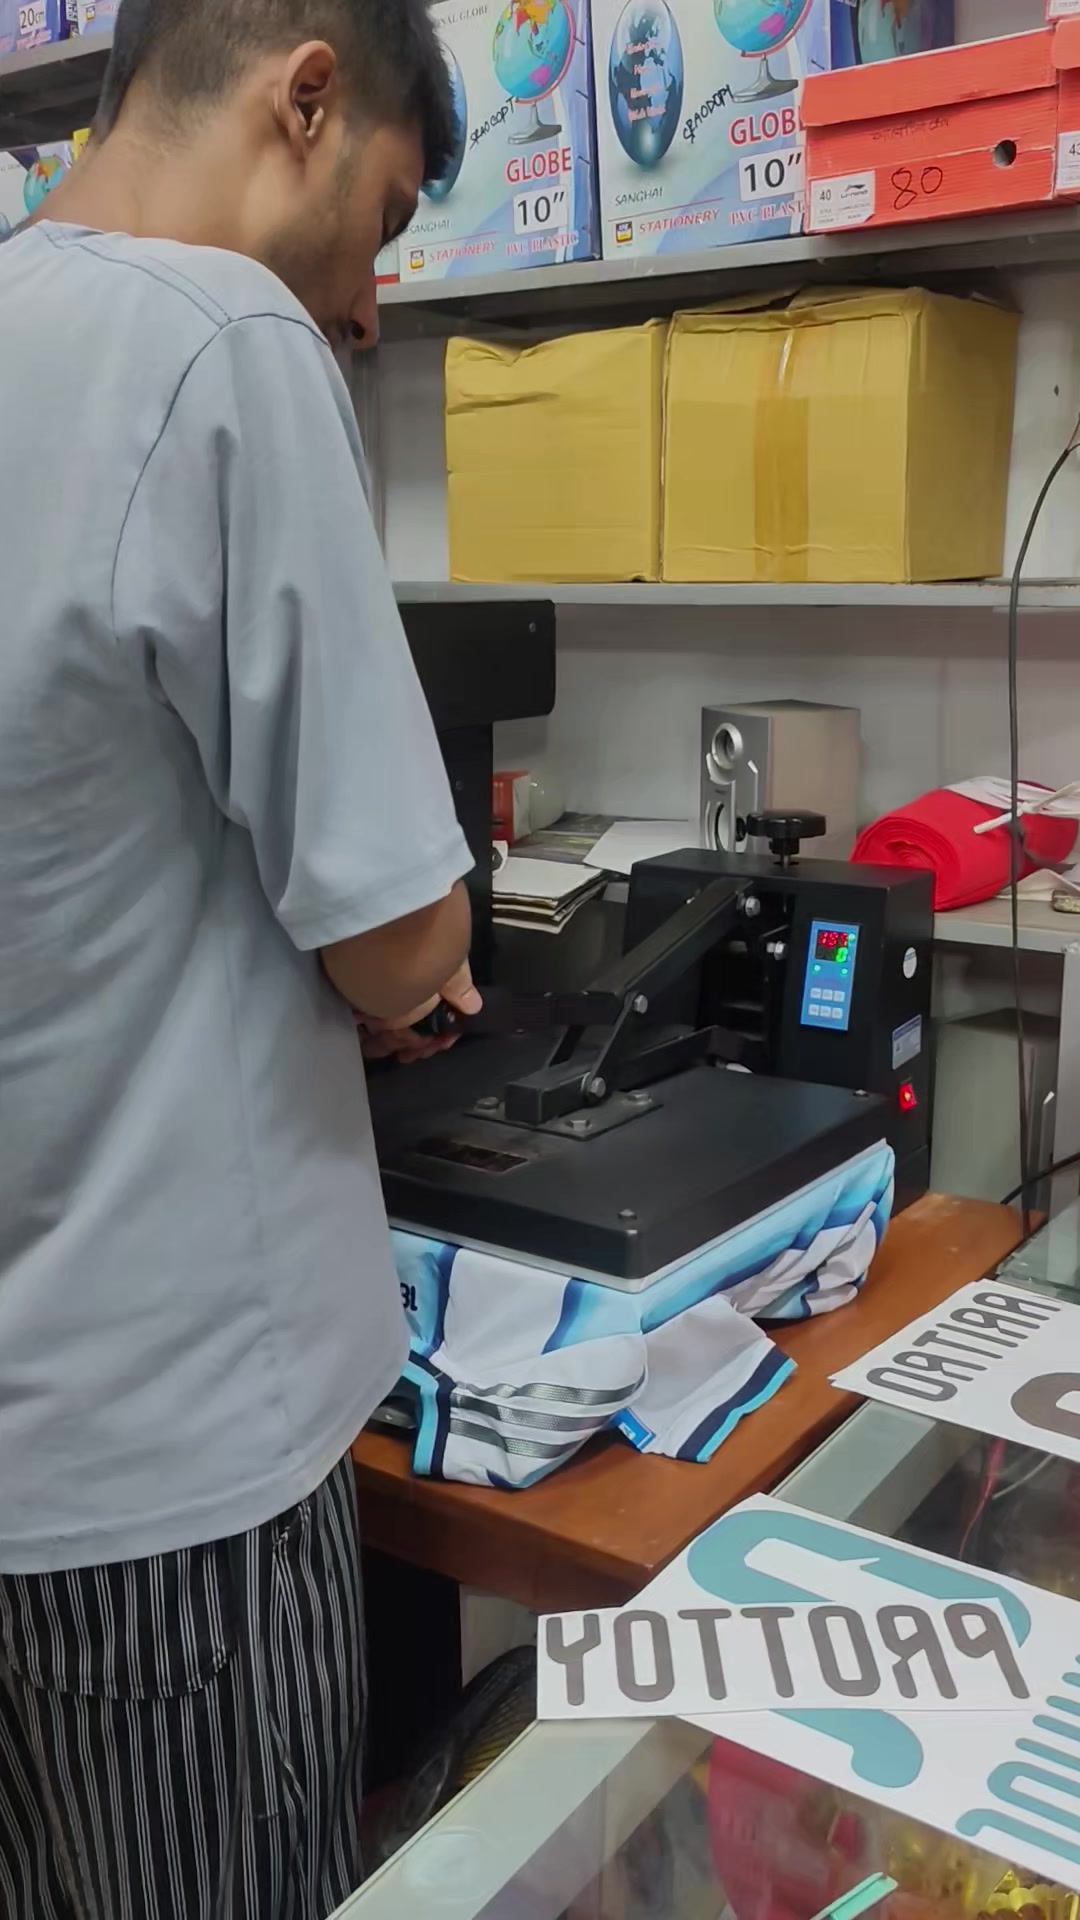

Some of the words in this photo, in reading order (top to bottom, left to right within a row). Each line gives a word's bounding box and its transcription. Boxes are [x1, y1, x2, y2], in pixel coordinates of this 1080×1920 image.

[730, 108, 796, 145] GLOB
[505, 147, 572, 184] GLOBE
[615, 187, 663, 206] SANGHAI
[819, 189, 831, 200] 40
[891, 166, 943, 210] 80
[514, 191, 565, 226] 10"
[639, 208, 719, 233] STATIONERY
[762, 201, 804, 219] PLAST
[429, 241, 496, 262] STATIONERY
